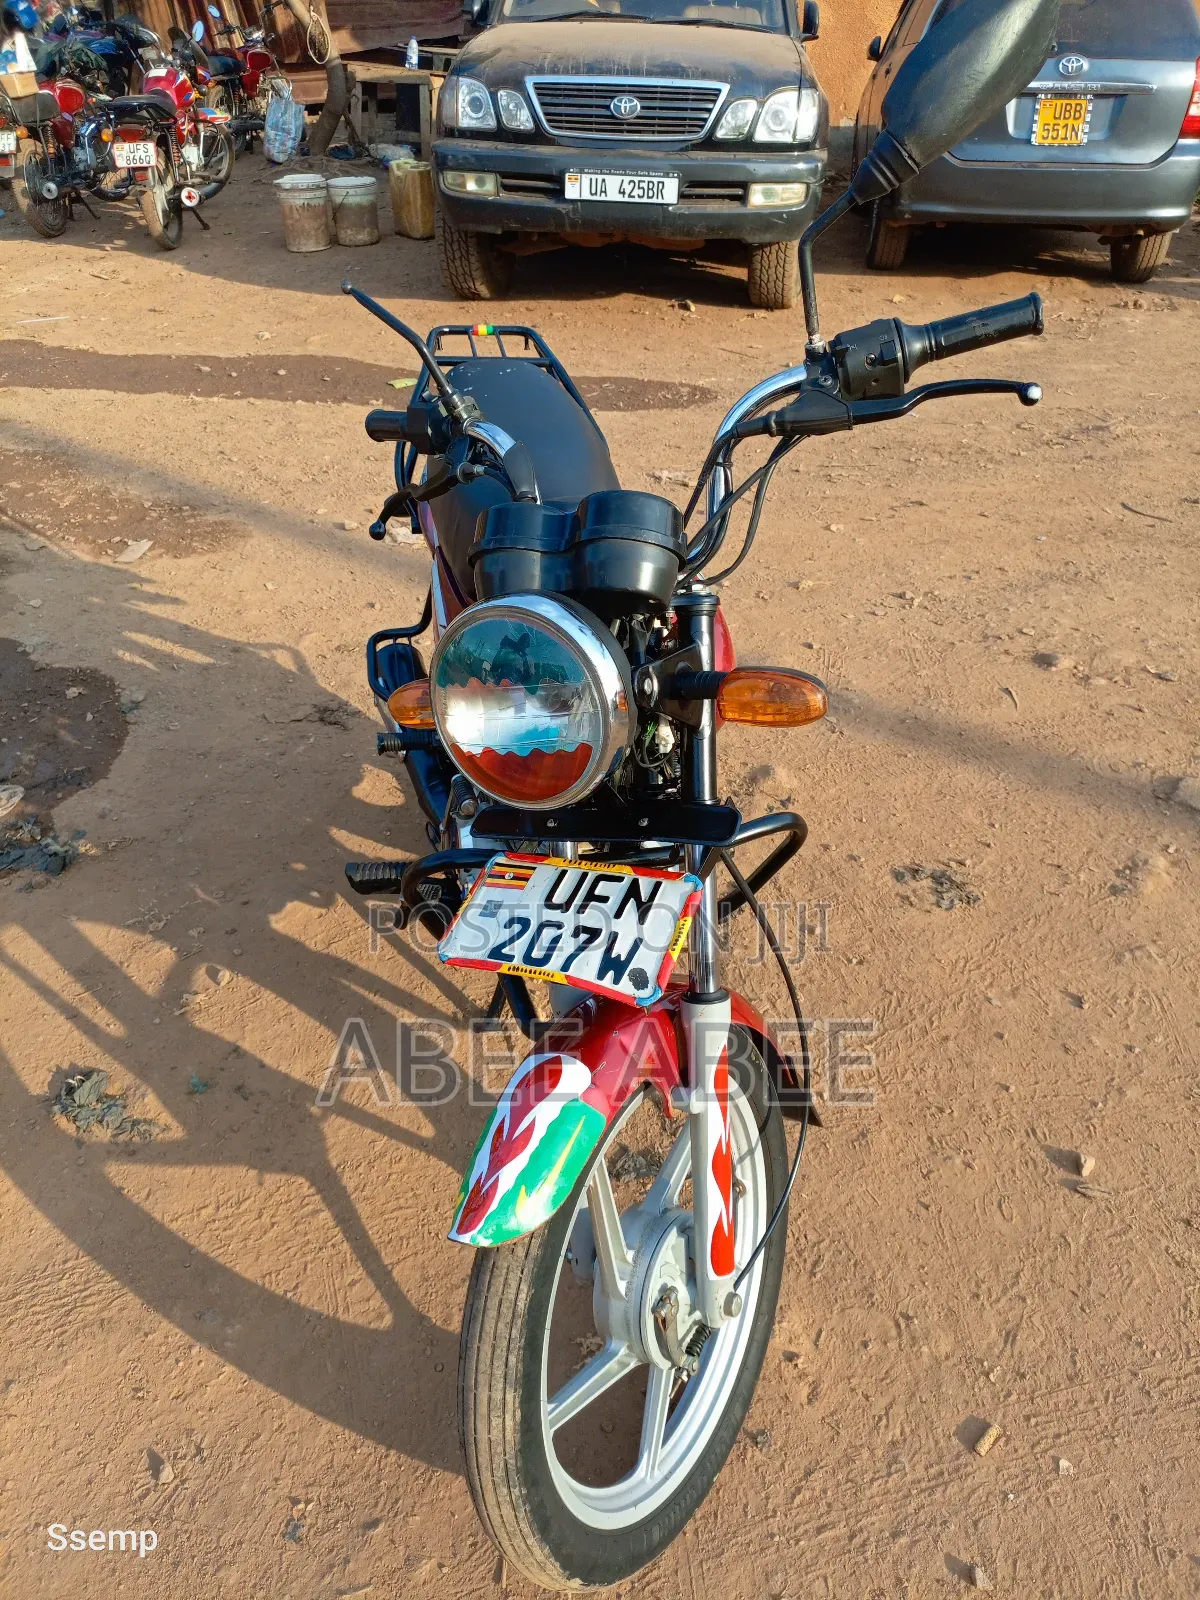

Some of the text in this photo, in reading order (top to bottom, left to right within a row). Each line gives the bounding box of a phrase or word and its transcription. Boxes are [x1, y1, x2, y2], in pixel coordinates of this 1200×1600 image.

[1053, 102, 1083, 120] UBB
[1041, 123, 1080, 141] 551N
[128, 144, 149, 154] UFS
[589, 177, 665, 200] UA 425BR
[544, 869, 663, 926] UFN
[487, 916, 643, 986] 207W
